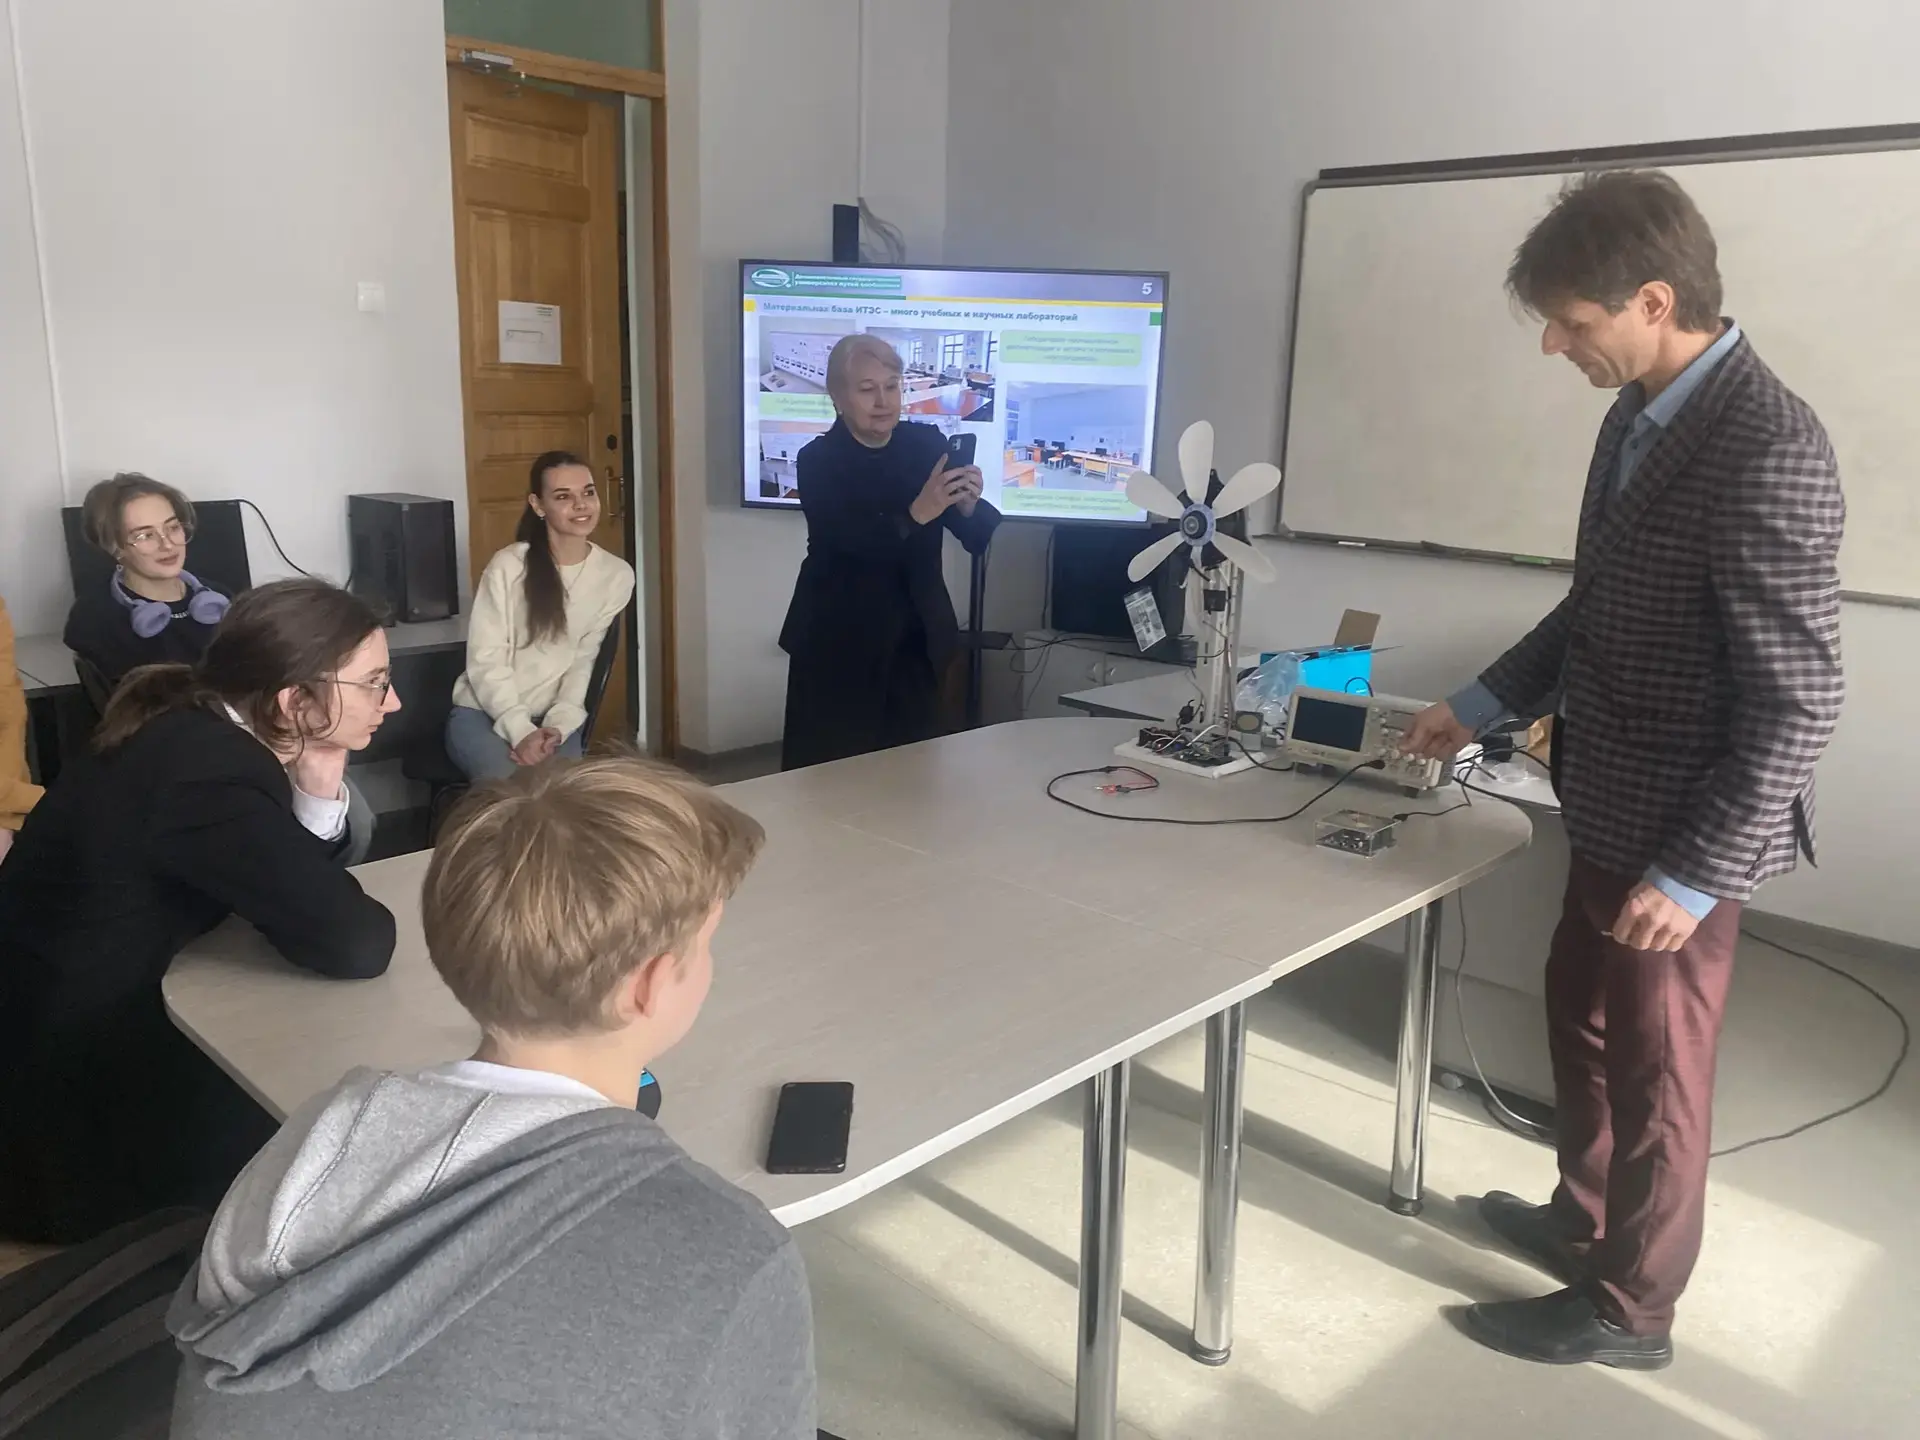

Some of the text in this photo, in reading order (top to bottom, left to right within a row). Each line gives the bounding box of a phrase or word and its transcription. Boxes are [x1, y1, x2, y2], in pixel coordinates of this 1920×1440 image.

[1141, 282, 1153, 295] 5
[763, 302, 829, 314] Материальная
[831, 305, 853, 314] база
[855, 306, 882, 315] ИТЭС
[890, 308, 919, 317] много
[920, 309, 962, 319] учебных
[972, 311, 1014, 321] научных
[1016, 312, 1078, 322] лабораторий
